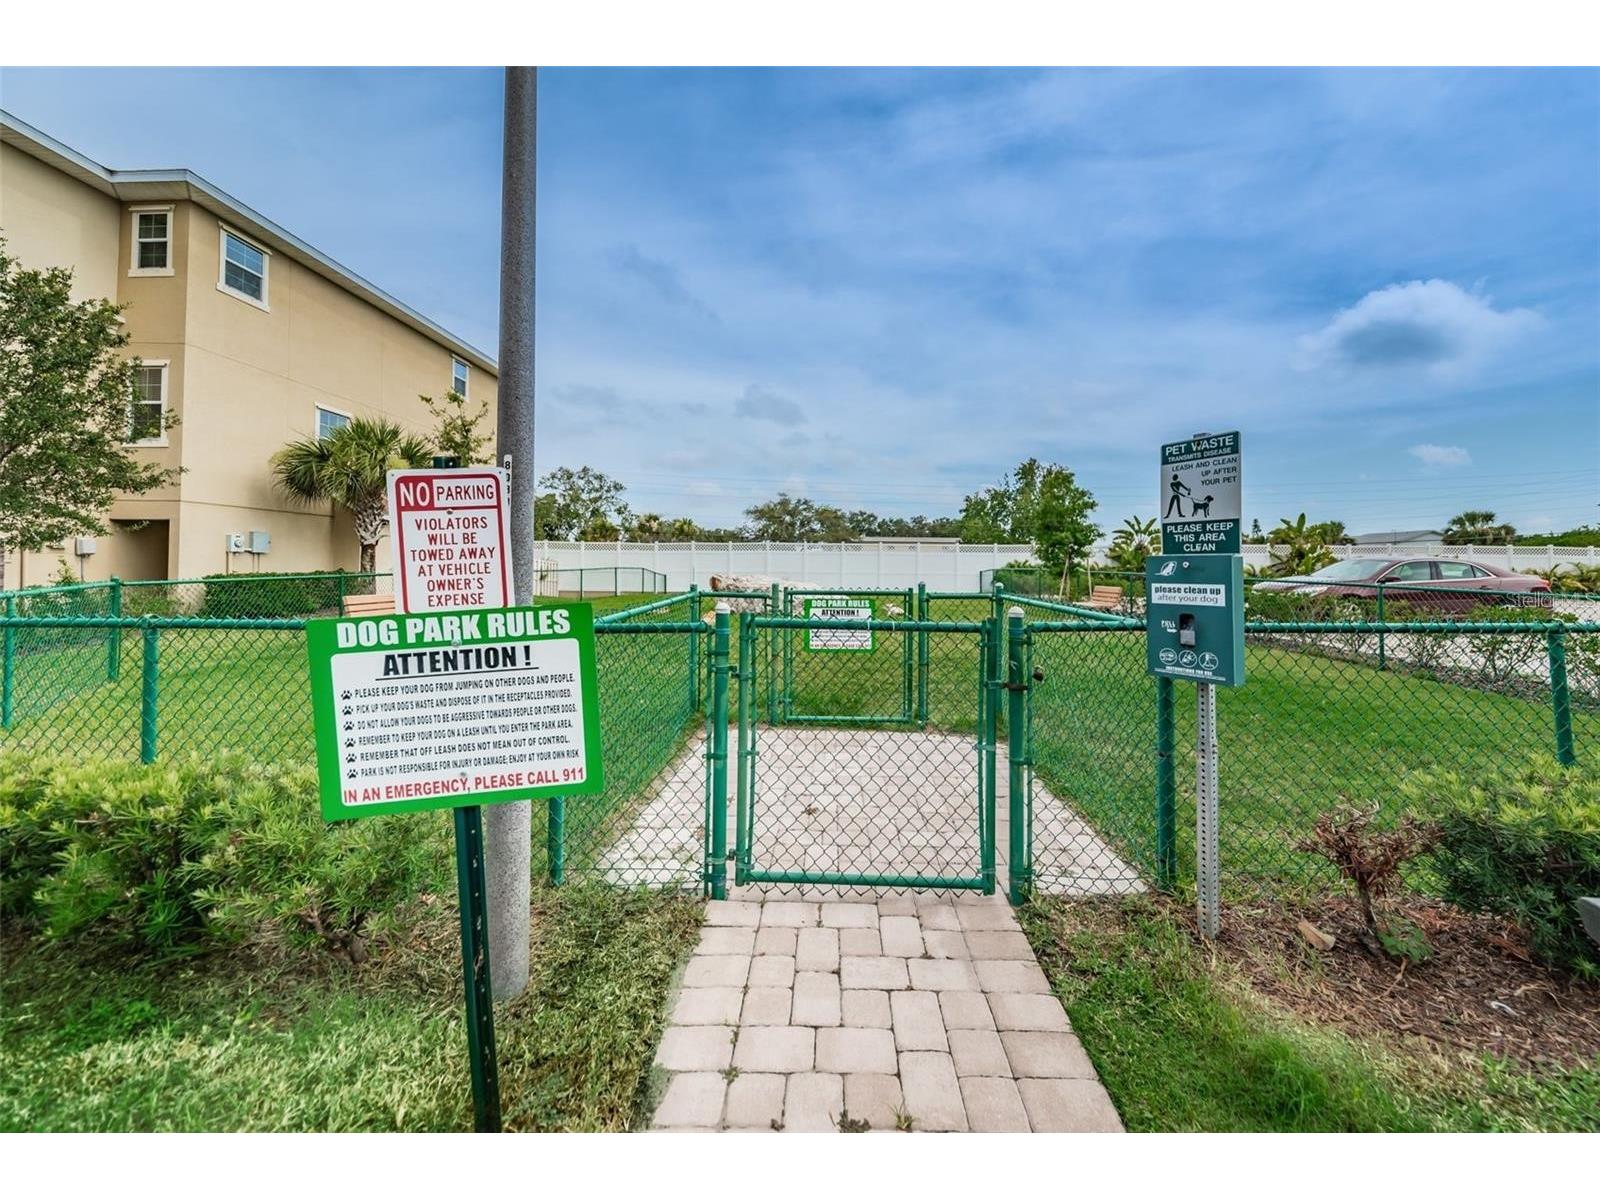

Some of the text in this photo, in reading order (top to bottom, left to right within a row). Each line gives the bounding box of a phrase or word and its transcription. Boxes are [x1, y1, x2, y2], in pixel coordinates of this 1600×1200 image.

[1166, 435, 1234, 456] PET WASTE
[1168, 447, 1231, 462] TRANSMITS DISEASE
[1172, 464, 1193, 472] LEASH
[1213, 457, 1237, 466] CLEAN
[1214, 466, 1236, 475] AFTER
[1201, 478, 1220, 486] YOUR
[400, 482, 494, 506] NO PARKING
[415, 517, 487, 531] VIOLATORS
[1167, 522, 1233, 533] PLEASE KEEP
[428, 533, 477, 545] WILL BE
[1174, 533, 1225, 542] THIS AREA
[411, 547, 495, 562] TOWED AWAY
[1183, 543, 1215, 552] CLEAN
[418, 562, 491, 576] AT VEHICLE
[427, 578, 484, 592] OWNER'S
[428, 593, 484, 607] EXPENSE
[1200, 595, 1218, 604] dog
[337, 609, 570, 648] DOG PARK RULES
[383, 647, 517, 676] ATTENTION
[355, 673, 575, 698] PLEASE KEEP YOUR DOG FROM JUMPING ON OTHER DOGS AND PEOPLE.
[356, 689, 572, 714] PICK UP YOUR DOG'S WASTE AND DISPOSE OF IT IN THE RECEPTACLES PROVIDED.
[358, 704, 577, 730] DO NOT ALLOW YOUR DOGS TO BE AGGRESSIVE TOWARDS PEOPLE OR OTHER DOGS.
[359, 720, 573, 745] REMEMBER TO KEEP YOUR DOG ON A LEASH UNTIL YOU ENTER THE PARK AREA.
[360, 735, 570, 760] REMEMBER THAT OFF LEASH DOES NOT MEAN OUT OF CONTROL.
[361, 767, 376, 777] PARK
[378, 766, 384, 775] IS
[385, 765, 397, 775] NOT
[399, 761, 437, 774] RESPONSIBLE
[440, 760, 450, 770] FOR
[452, 758, 472, 769] INJURY
[474, 758, 481, 767] OR
[509, 754, 526, 763] ENJOY
[528, 753, 535, 761] AT
[536, 751, 551, 760] YOUR
[552, 750, 565, 759] OWN
[567, 749, 579, 758] RISK
[344, 767, 584, 803] IN AN EMERGENCY, PLEASE CALL 911
